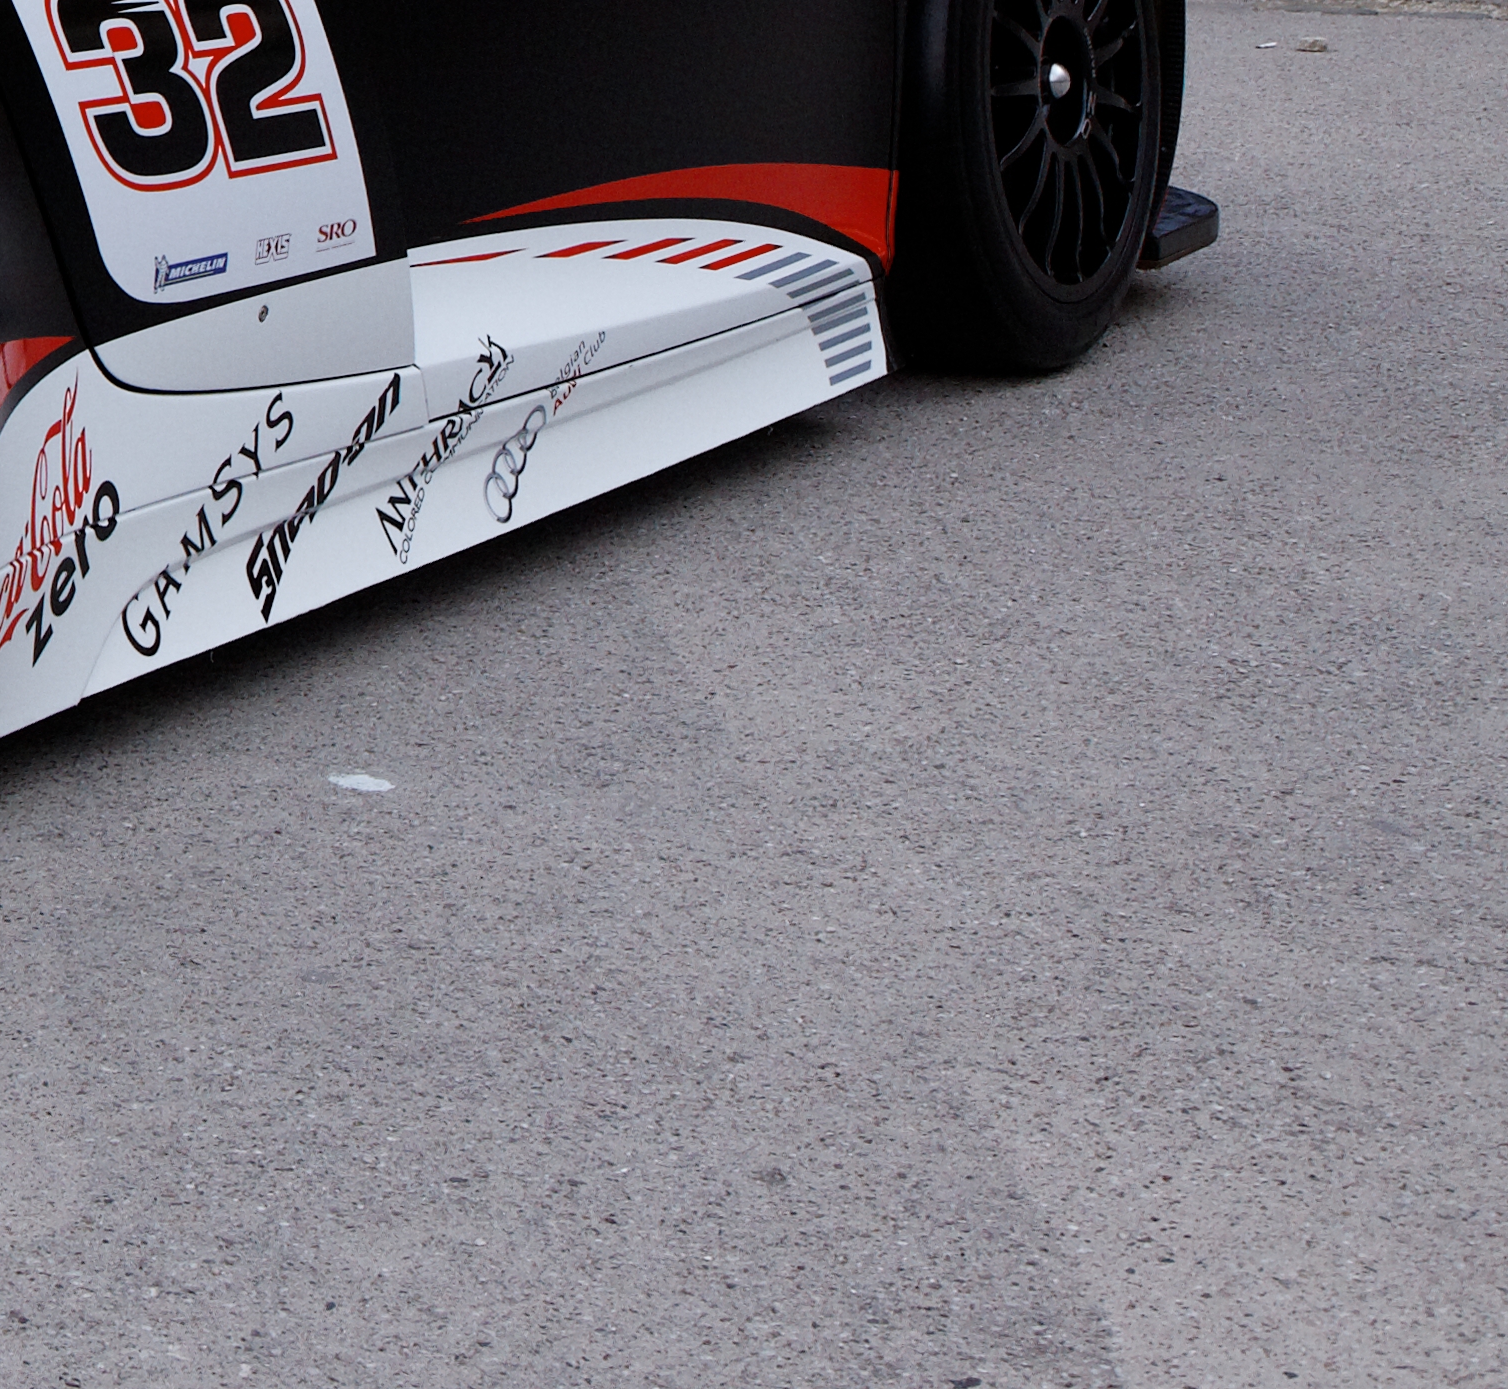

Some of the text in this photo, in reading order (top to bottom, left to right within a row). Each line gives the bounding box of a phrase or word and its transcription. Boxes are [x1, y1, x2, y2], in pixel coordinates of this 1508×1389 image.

[317, 218, 357, 243] SRO
[255, 233, 291, 265] HEXIS
[168, 257, 226, 280] MICHELIN
[584, 330, 607, 366] Club
[122, 390, 294, 657] GAMSYS
[399, 486, 426, 565] COLORED
[26, 480, 120, 667] zero
